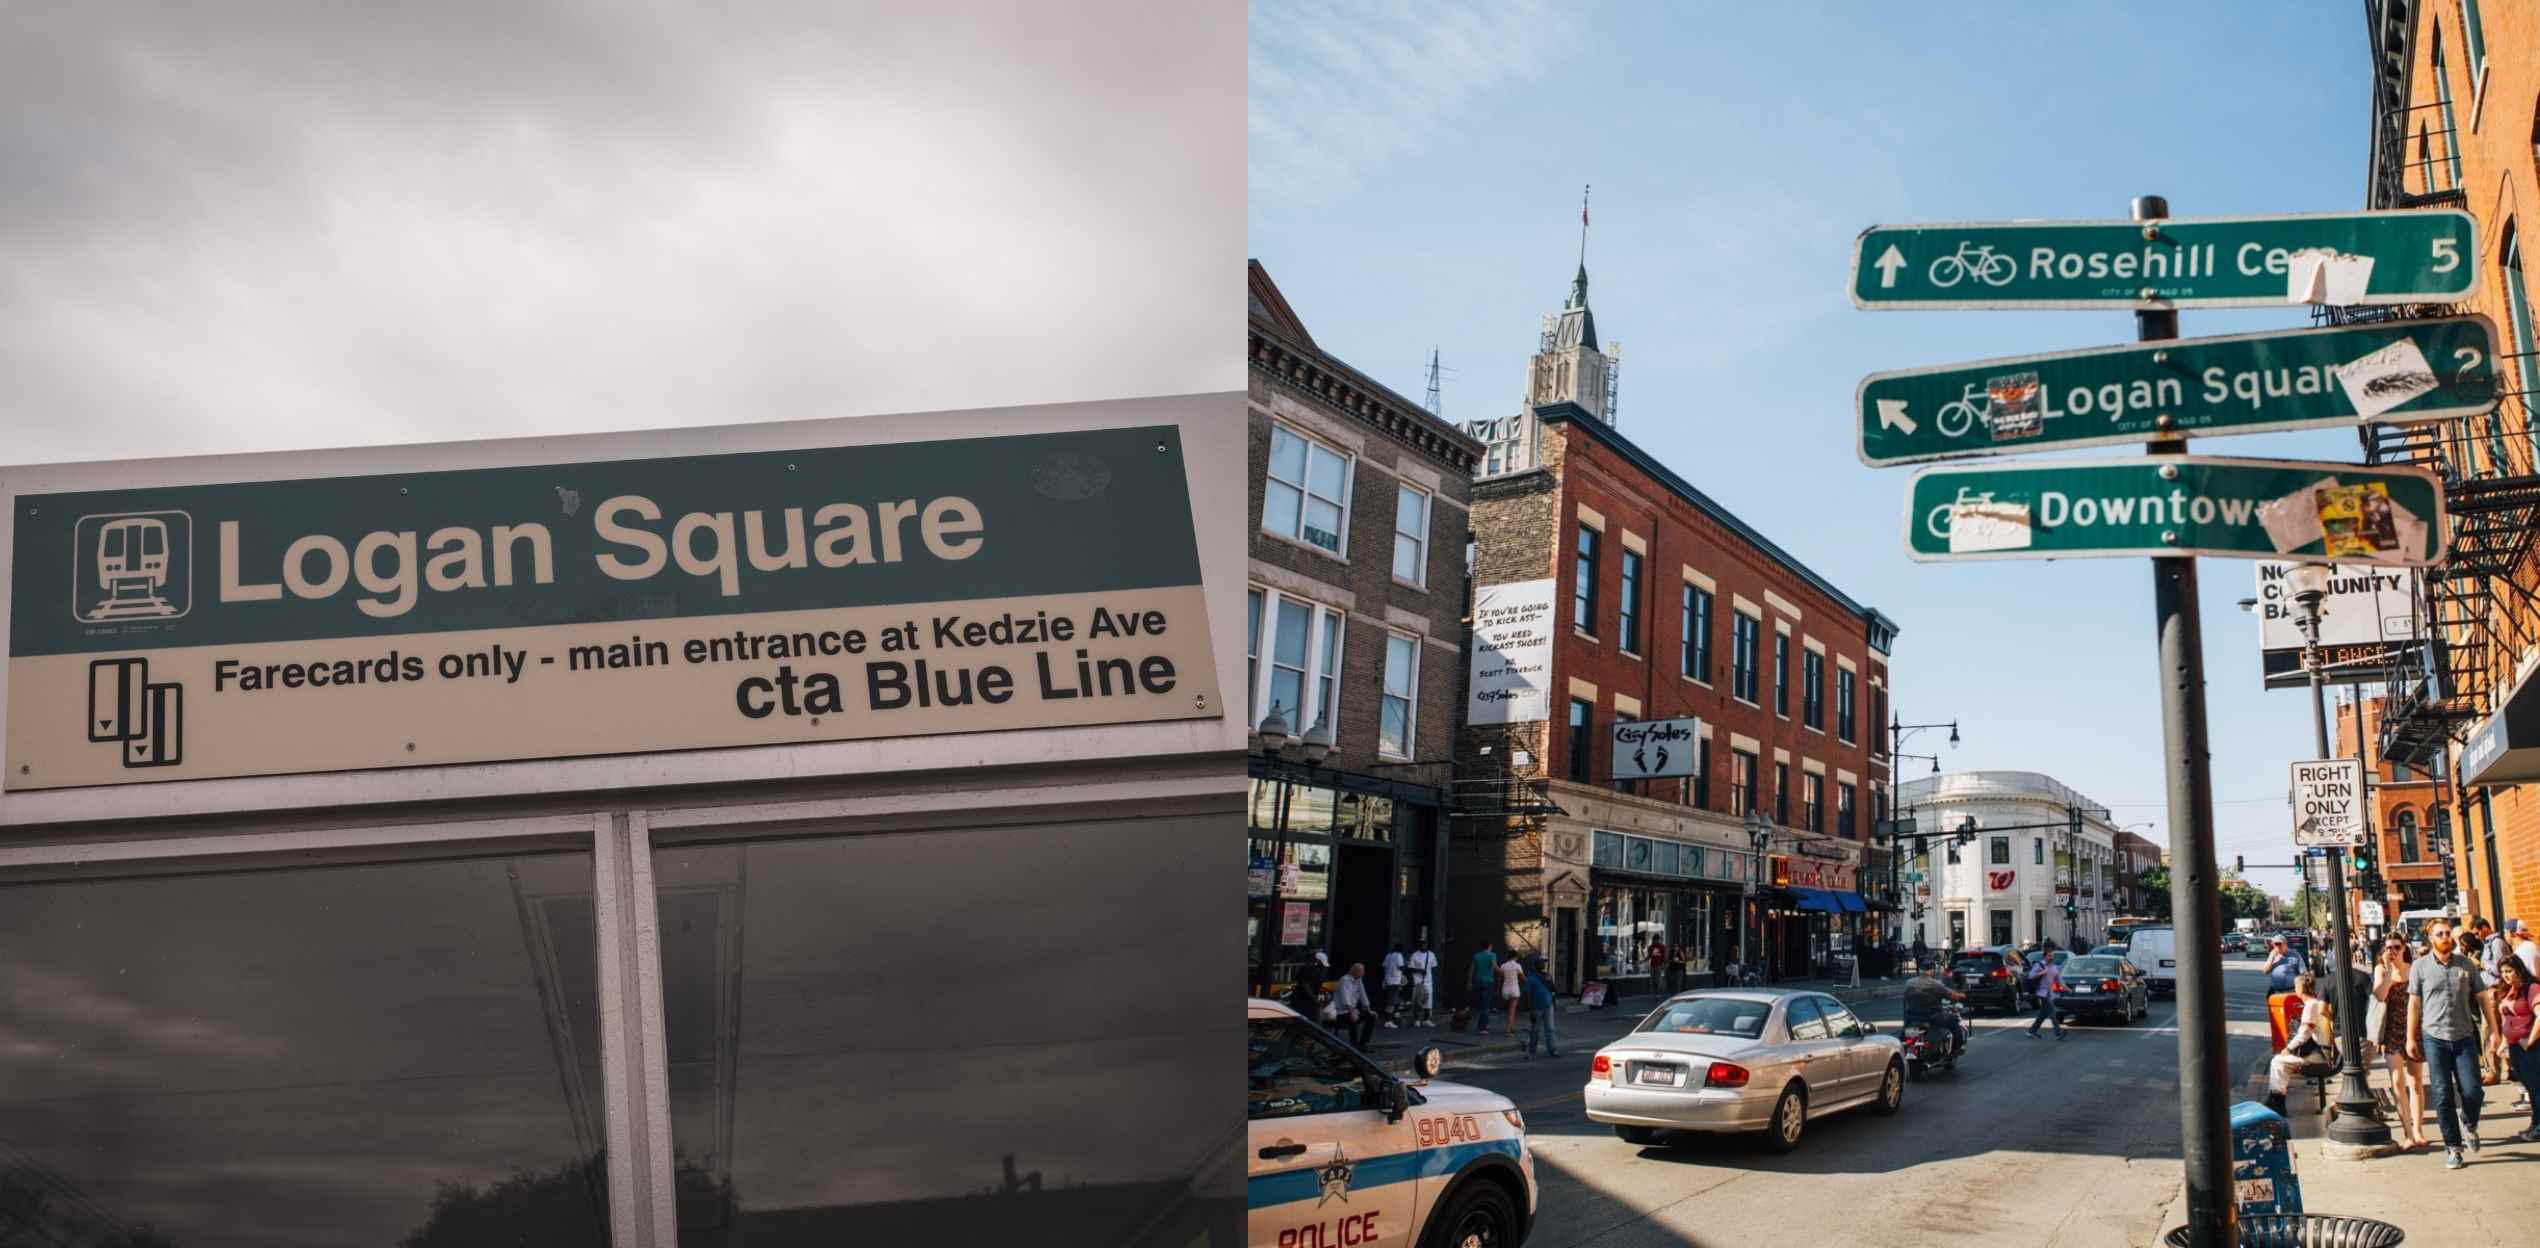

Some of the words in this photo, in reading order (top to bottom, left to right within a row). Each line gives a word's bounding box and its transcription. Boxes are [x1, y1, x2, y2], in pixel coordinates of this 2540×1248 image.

[2029, 244, 2214, 280] Rosehill
[2237, 241, 2338, 277] Ce
[2431, 238, 2460, 274] 5
[2041, 377, 2182, 423] Logan
[2202, 363, 2342, 408] Squar
[2453, 346, 2484, 386] 2
[218, 516, 555, 618] Logan
[593, 491, 985, 598] Square
[2263, 574, 2402, 600] CUNITY
[1496, 616, 1517, 624] KICK
[1521, 603, 1549, 613] GOING
[213, 649, 425, 692] Farecards
[438, 643, 528, 684] only
[541, 655, 555, 664] -
[568, 635, 669, 672] main
[683, 624, 868, 664] entrance
[880, 618, 920, 652] at
[932, 610, 1076, 649] Kedzie
[1088, 605, 1167, 640] Ave
[1493, 633, 1508, 641] YOU
[736, 663, 843, 719] cta
[866, 659, 1014, 711] Blue
[1037, 649, 1177, 701] Line
[2300, 766, 2351, 781] RIGHT
[2305, 799, 2351, 815] ONLY
[2314, 816, 2350, 827] XCEPT
[1419, 1116, 1481, 1146] 9040
[1279, 1210, 1380, 1248] POLICE
